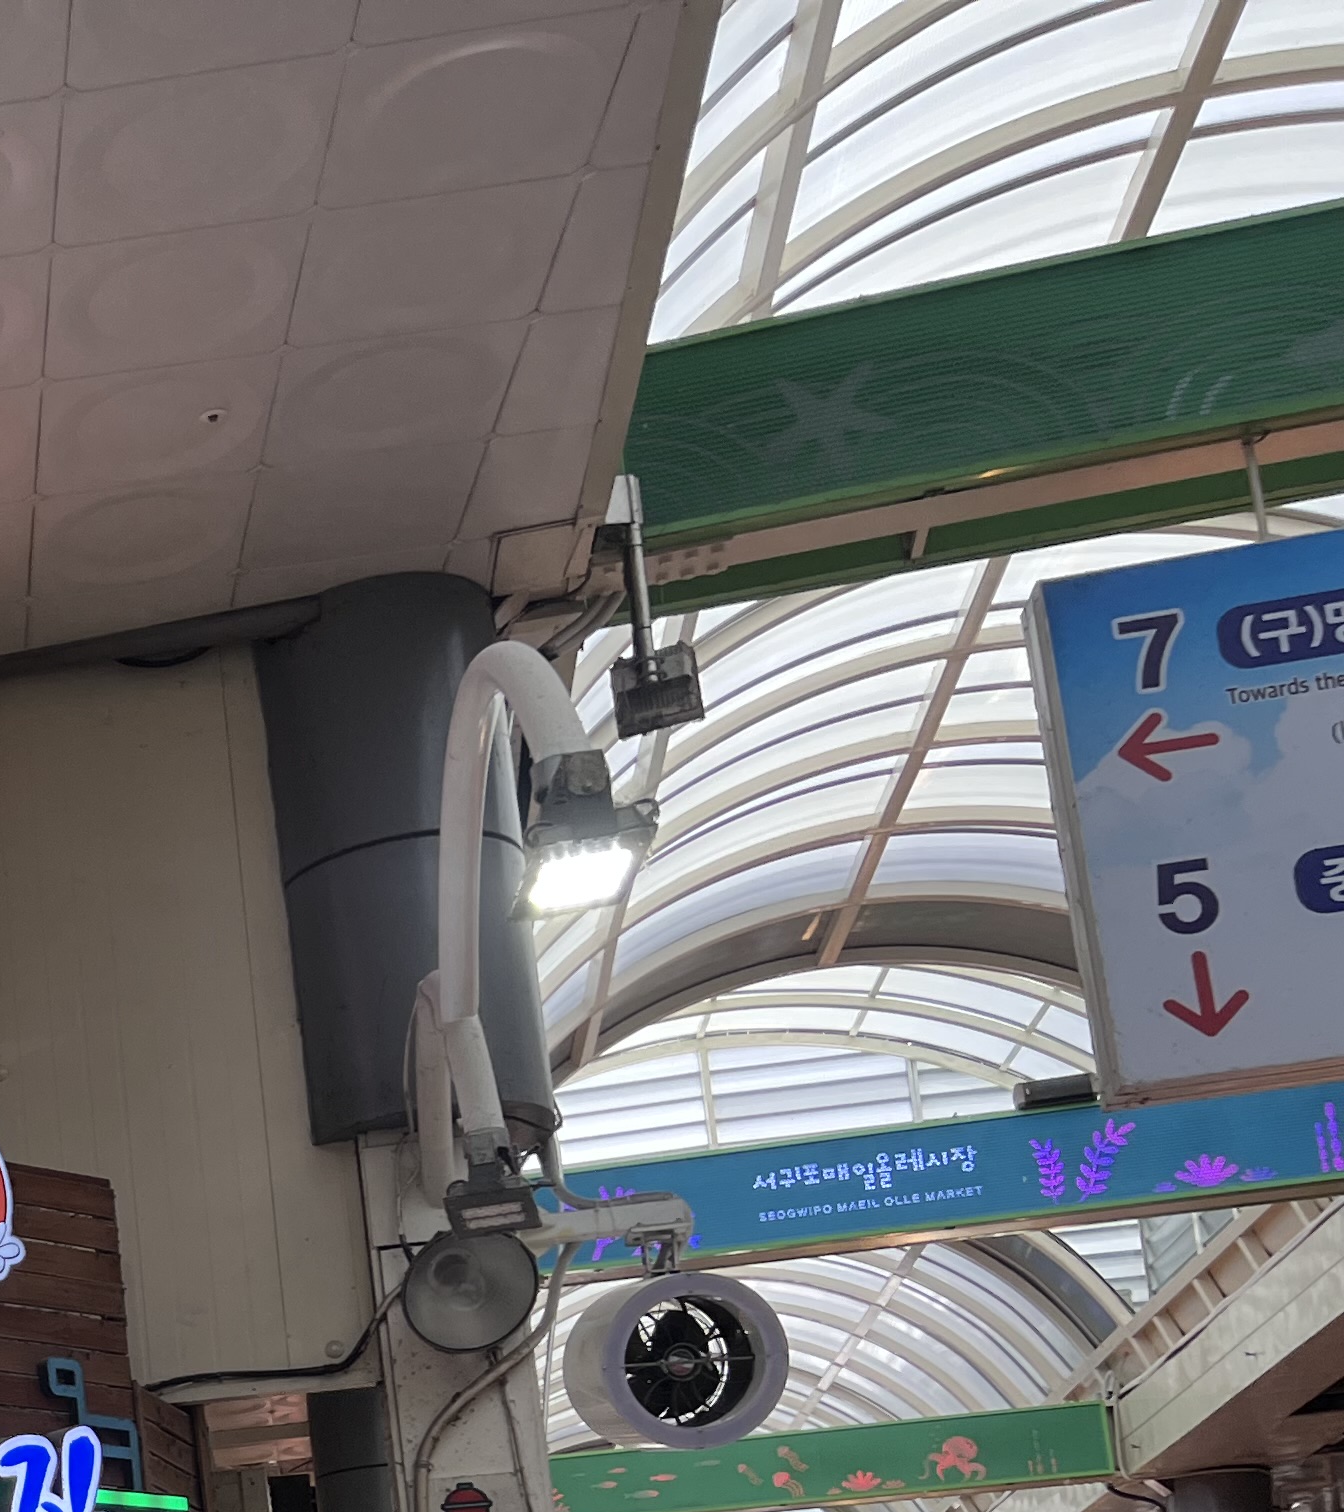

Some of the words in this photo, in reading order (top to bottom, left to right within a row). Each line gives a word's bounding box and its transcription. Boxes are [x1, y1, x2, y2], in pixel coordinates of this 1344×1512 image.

[1111, 607, 1186, 693] 7
[1225, 678, 1309, 704] Towards
[1156, 857, 1218, 935] 5
[753, 1145, 978, 1190] 서귀포매일올레시장
[759, 1204, 832, 1222] SEOGWIPO
[837, 1199, 880, 1212] MAEIL
[884, 1193, 920, 1207] OLLE
[925, 1186, 983, 1202] MARKET
